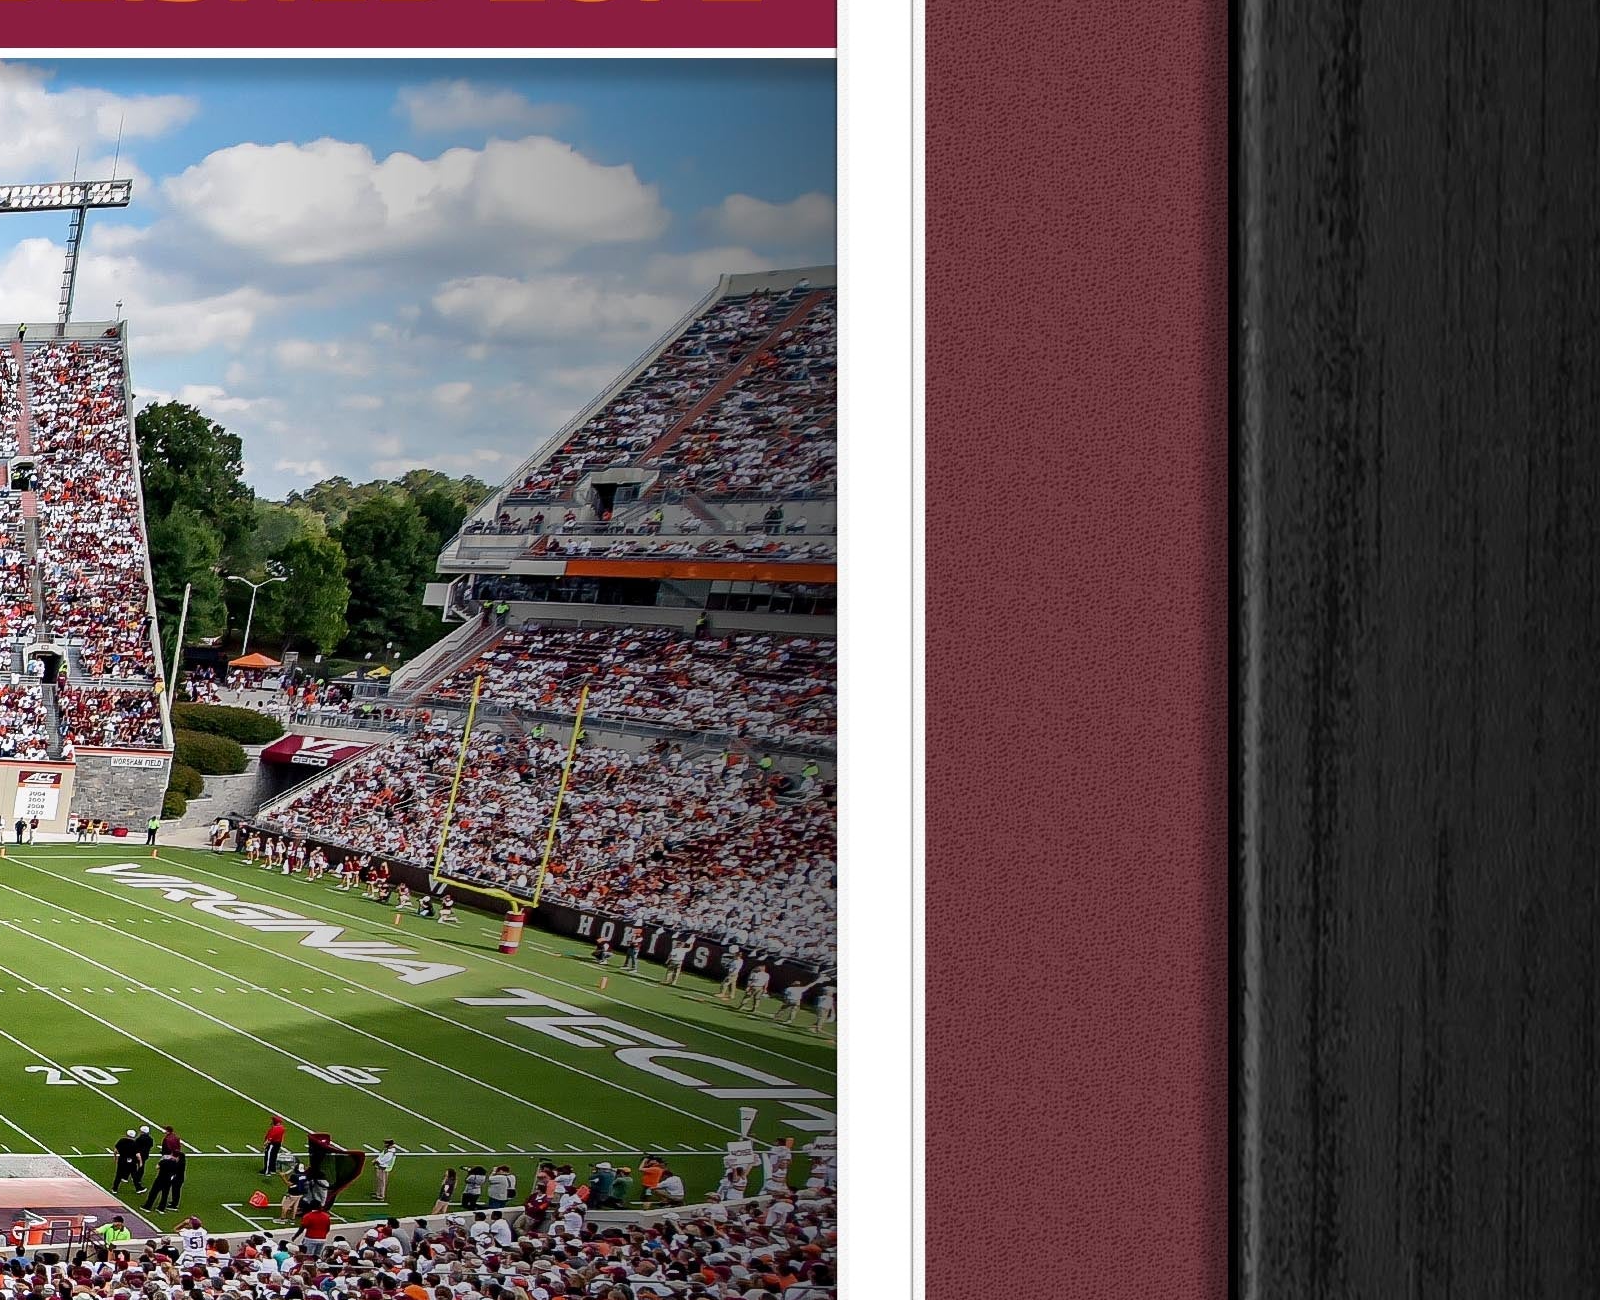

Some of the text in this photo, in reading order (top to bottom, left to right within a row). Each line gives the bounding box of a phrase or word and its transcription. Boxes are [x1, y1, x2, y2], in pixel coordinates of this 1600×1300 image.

[291, 756, 328, 767] GEICO
[22, 772, 58, 783] ACC
[85, 863, 467, 986] VIRGINIA
[23, 1065, 121, 1086] 20
[295, 1064, 383, 1086] 10
